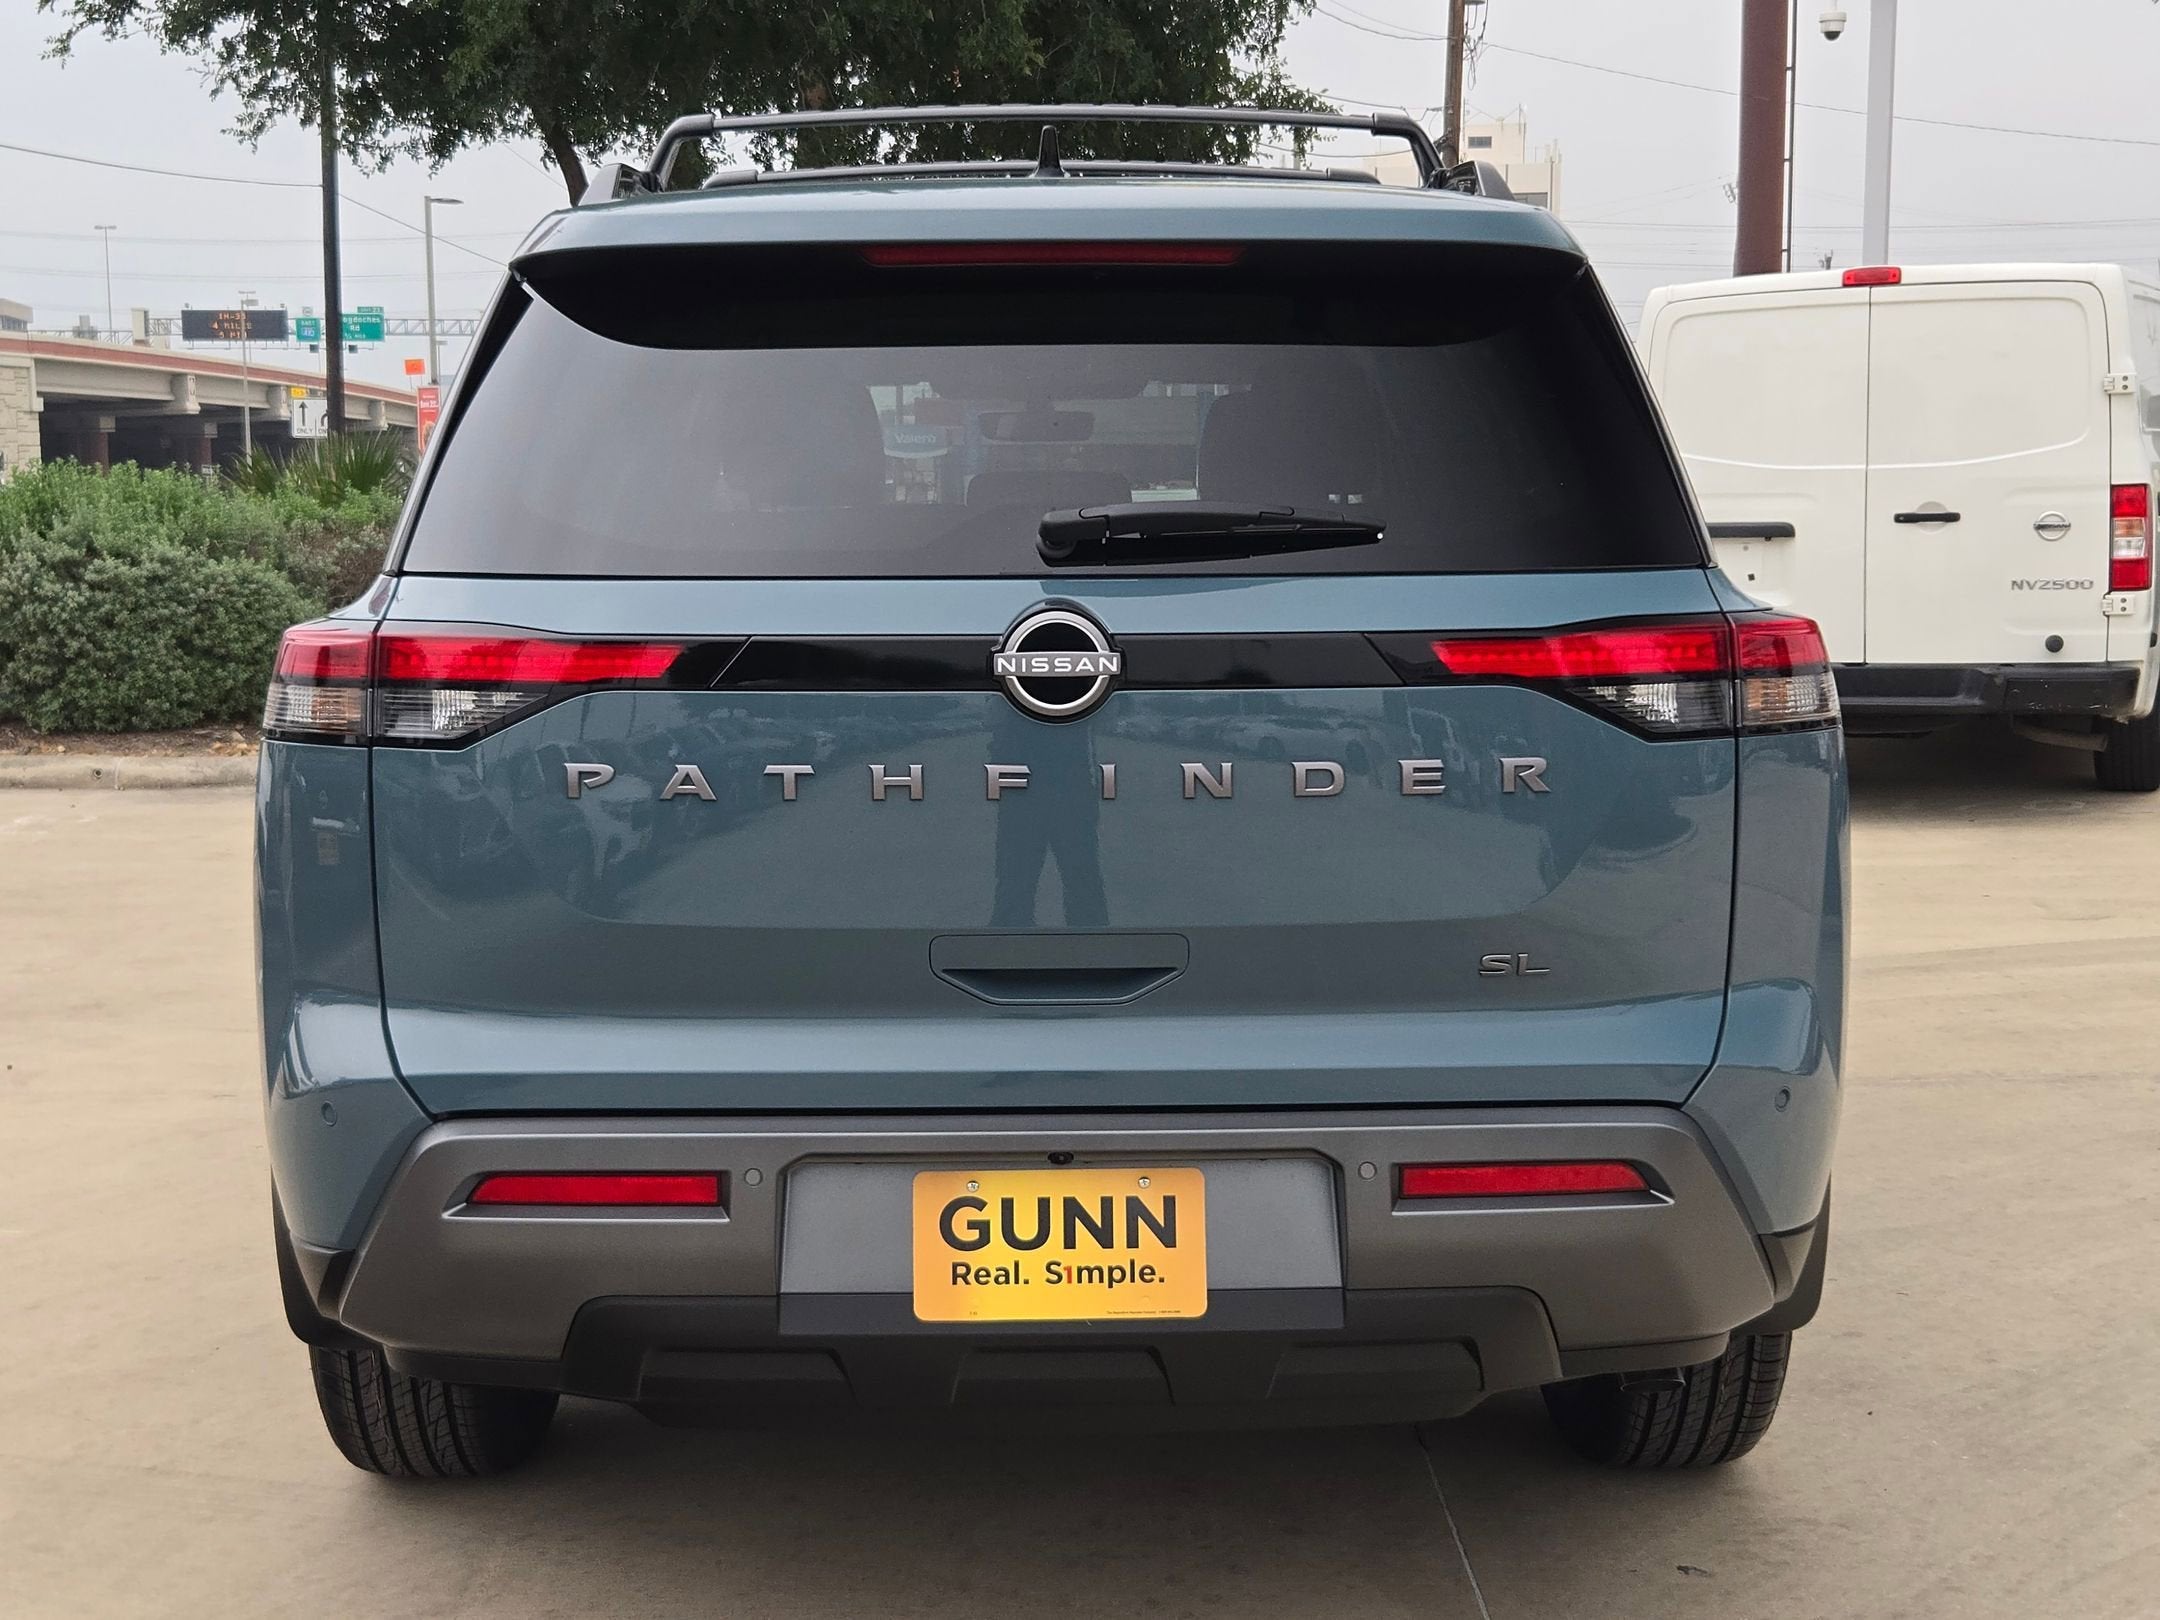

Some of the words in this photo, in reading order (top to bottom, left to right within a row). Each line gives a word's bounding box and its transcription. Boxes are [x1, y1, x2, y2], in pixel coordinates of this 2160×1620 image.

[224, 322, 253, 330] MILS
[342, 316, 381, 325] ogdoches
[2011, 579, 2094, 590] NV2500
[997, 656, 1118, 673] NISSAN
[563, 757, 1552, 801] PATHFINDER
[1479, 953, 1551, 976] SL
[939, 1194, 1177, 1251] GUNN
[951, 1260, 1030, 1286] Real.
